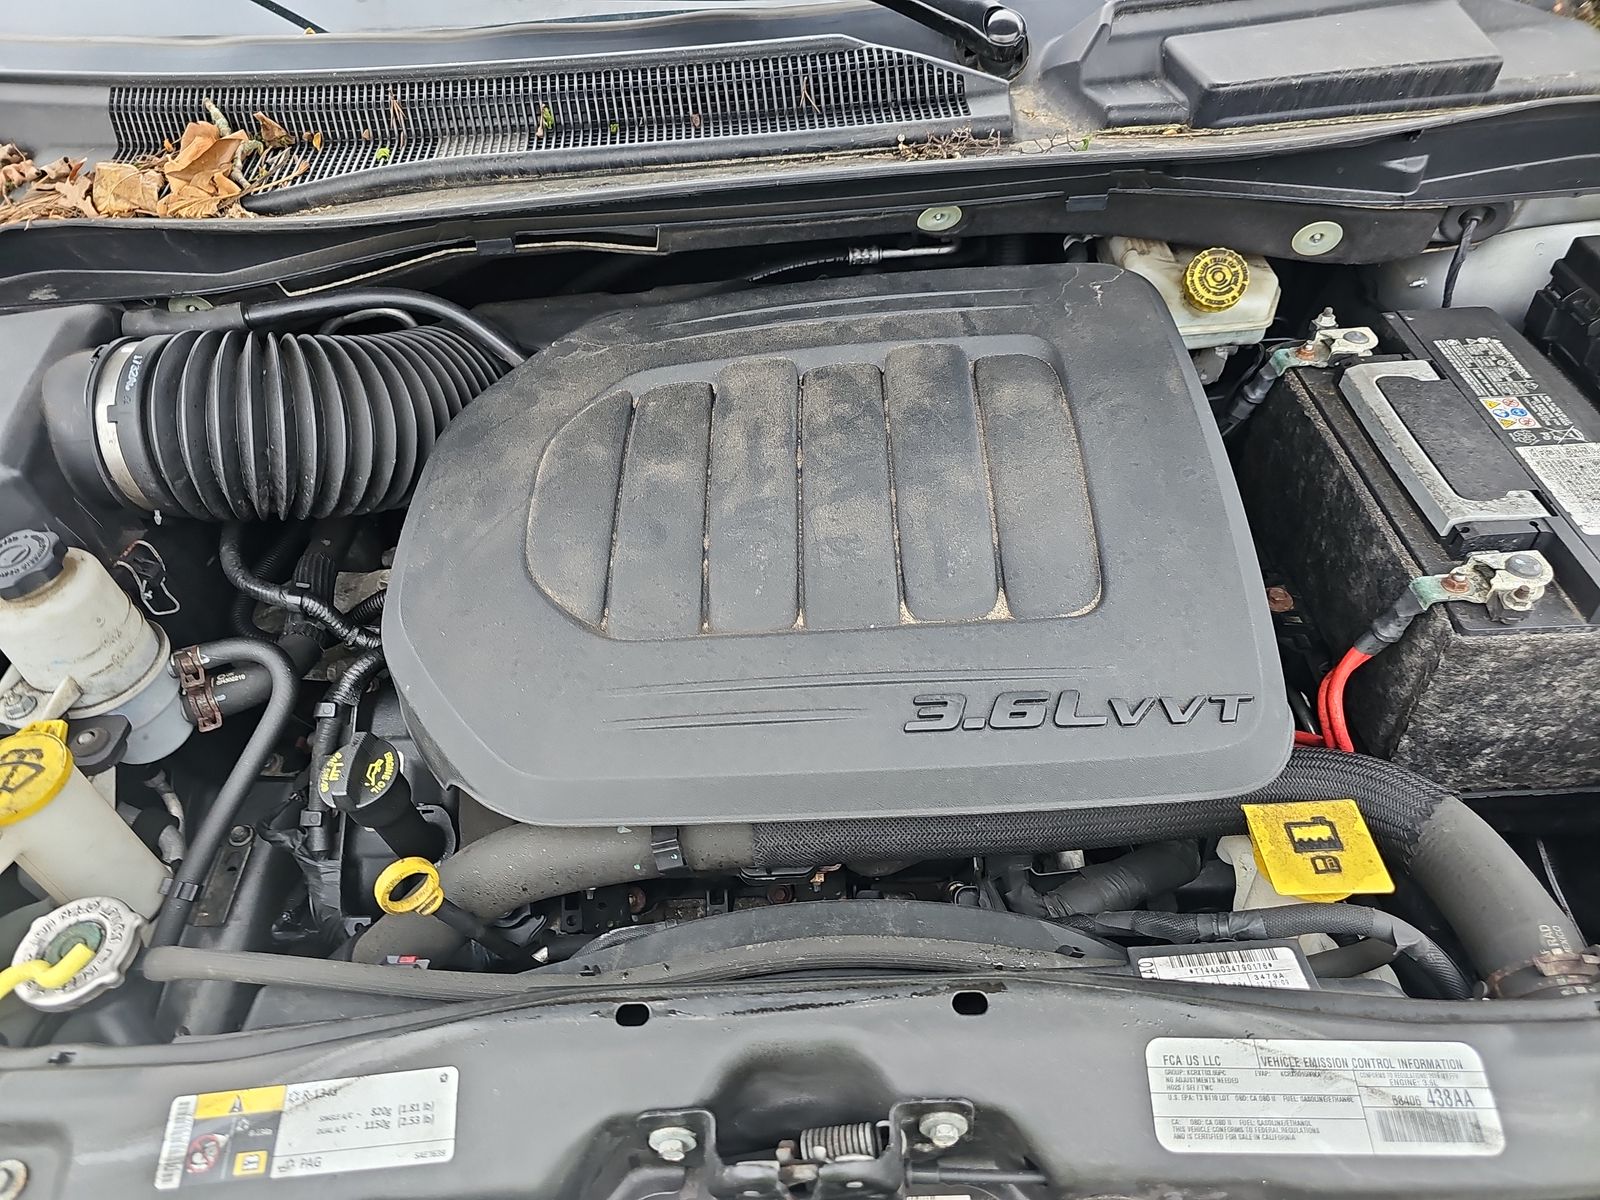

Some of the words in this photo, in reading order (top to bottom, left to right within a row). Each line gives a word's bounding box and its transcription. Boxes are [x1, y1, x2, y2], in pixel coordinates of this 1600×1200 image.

[370, 781, 386, 794] OIL
[1254, 973, 1285, 981] 3479A
[1162, 1054, 1182, 1066] FCA
[1185, 1055, 1200, 1066] US
[1203, 1055, 1221, 1066] LLC
[1260, 1055, 1300, 1068] VEHICLE
[1304, 1056, 1349, 1068] EMISSION
[1351, 1057, 1395, 1069] CONTROL
[1398, 1058, 1464, 1070] INFORMATION
[1427, 1088, 1475, 1107] 438AA
[300, 1156, 322, 1168] PAG
